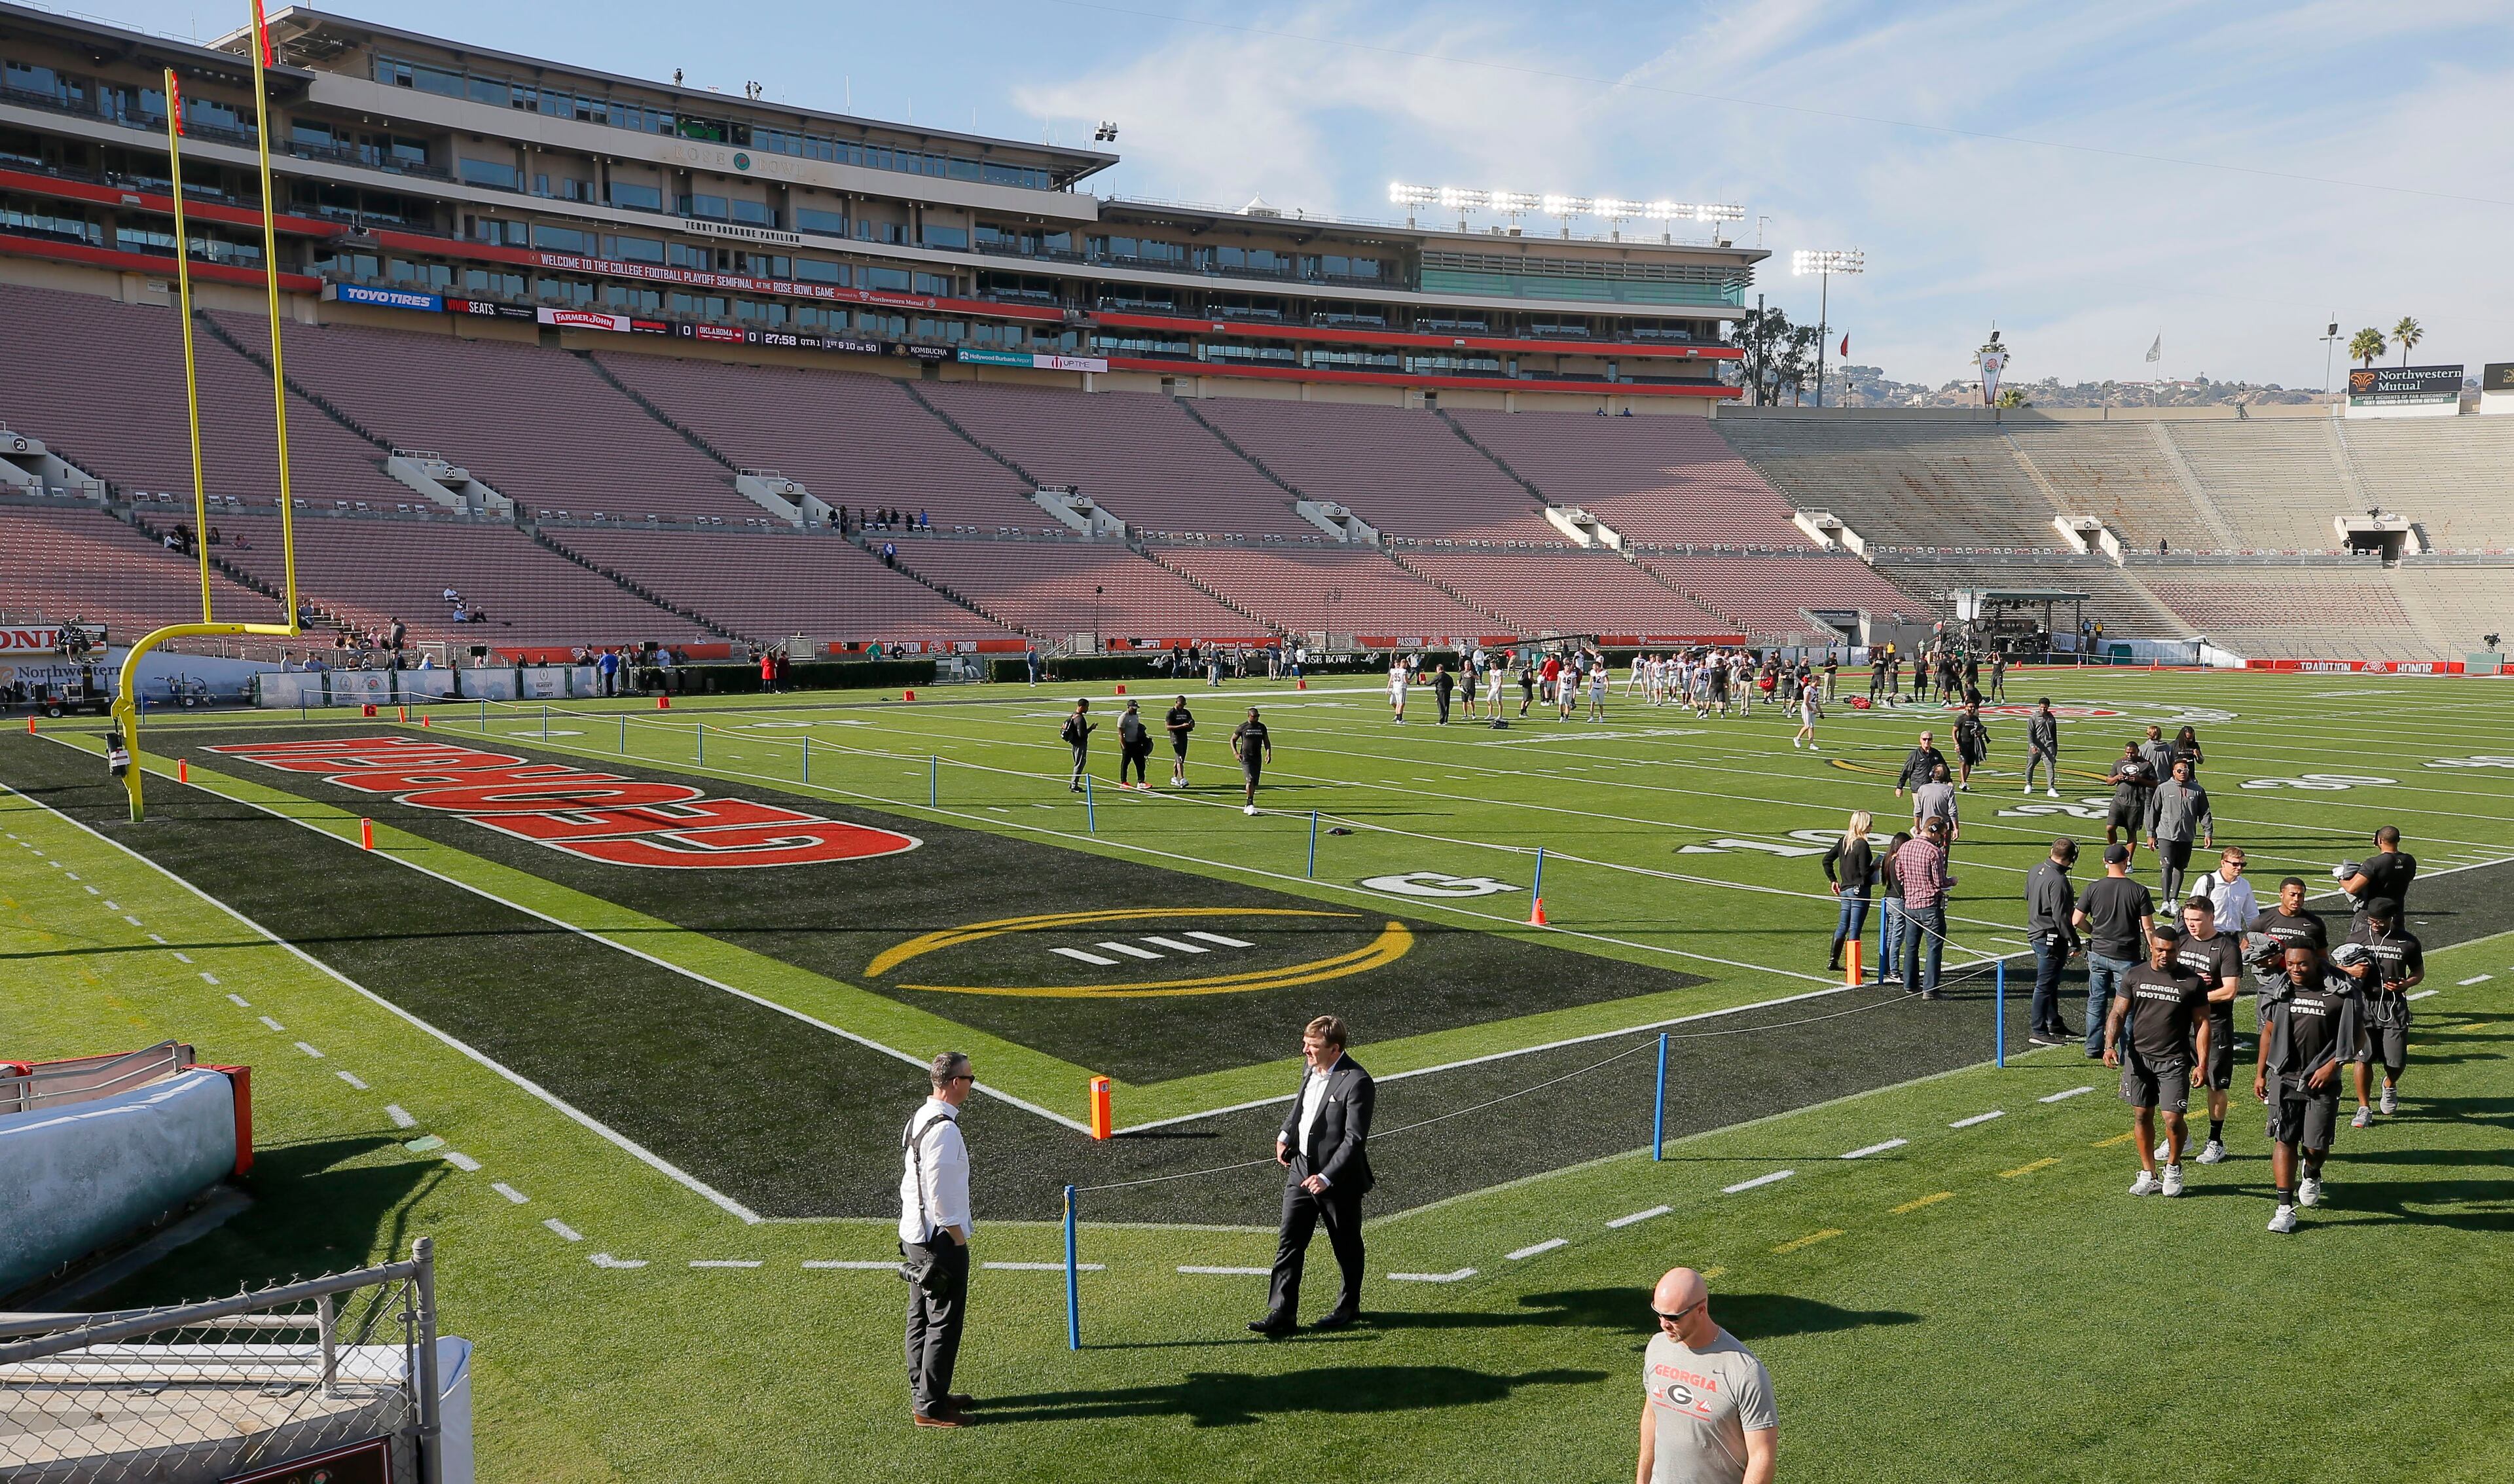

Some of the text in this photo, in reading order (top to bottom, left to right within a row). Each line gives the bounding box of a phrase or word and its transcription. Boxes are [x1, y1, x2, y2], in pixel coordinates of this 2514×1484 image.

[674, 145, 805, 177] ROSE BOWL
[685, 221, 800, 243] TERRY DONAHUE PAVILION
[541, 253, 579, 269] WELCOME
[583, 259, 592, 270] TO
[593, 260, 608, 272] THE
[610, 262, 643, 276] COLLEGE
[645, 266, 682, 281] FOOTBALL
[683, 272, 715, 285] PLAYOFF
[717, 276, 754, 289] SEMIFINAL
[773, 282, 792, 293] ROSE
[793, 284, 813, 296] BOWL
[816, 287, 834, 298] GAME
[348, 288, 430, 307] TOYO TIRES
[869, 296, 905, 304] Northwestern
[447, 299, 469, 312] VIVID
[555, 313, 612, 327] FARMER JOHN
[683, 325, 691, 336] 0
[699, 326, 733, 336] OKLAHOMA
[748, 332, 756, 342] 0
[765, 333, 797, 346] 27:58
[911, 346, 947, 356] KOMBUCHA
[970, 353, 995, 362] Hollywood
[2378, 369, 2462, 380] Northwestern
[2377, 380, 2422, 392] Mutual
[16, 441, 26, 450] 21
[1396, 638, 1422, 647] PASSION
[1304, 655, 1352, 664] OSE BOWL
[2300, 662, 2351, 671] TRADITION
[2397, 662, 2433, 673] HONOR
[1699, 672, 1709, 681] 49
[196, 736, 924, 869] GEORGIA
[1360, 871, 1525, 897] G
[2270, 927, 2306, 937] GEORGIA
[2180, 950, 2210, 964] GEORGIA
[2140, 983, 2180, 994] GEORGIA
[2136, 991, 2181, 1003] FOOTBALL
[1654, 1364, 1717, 1393] GEORGIA
